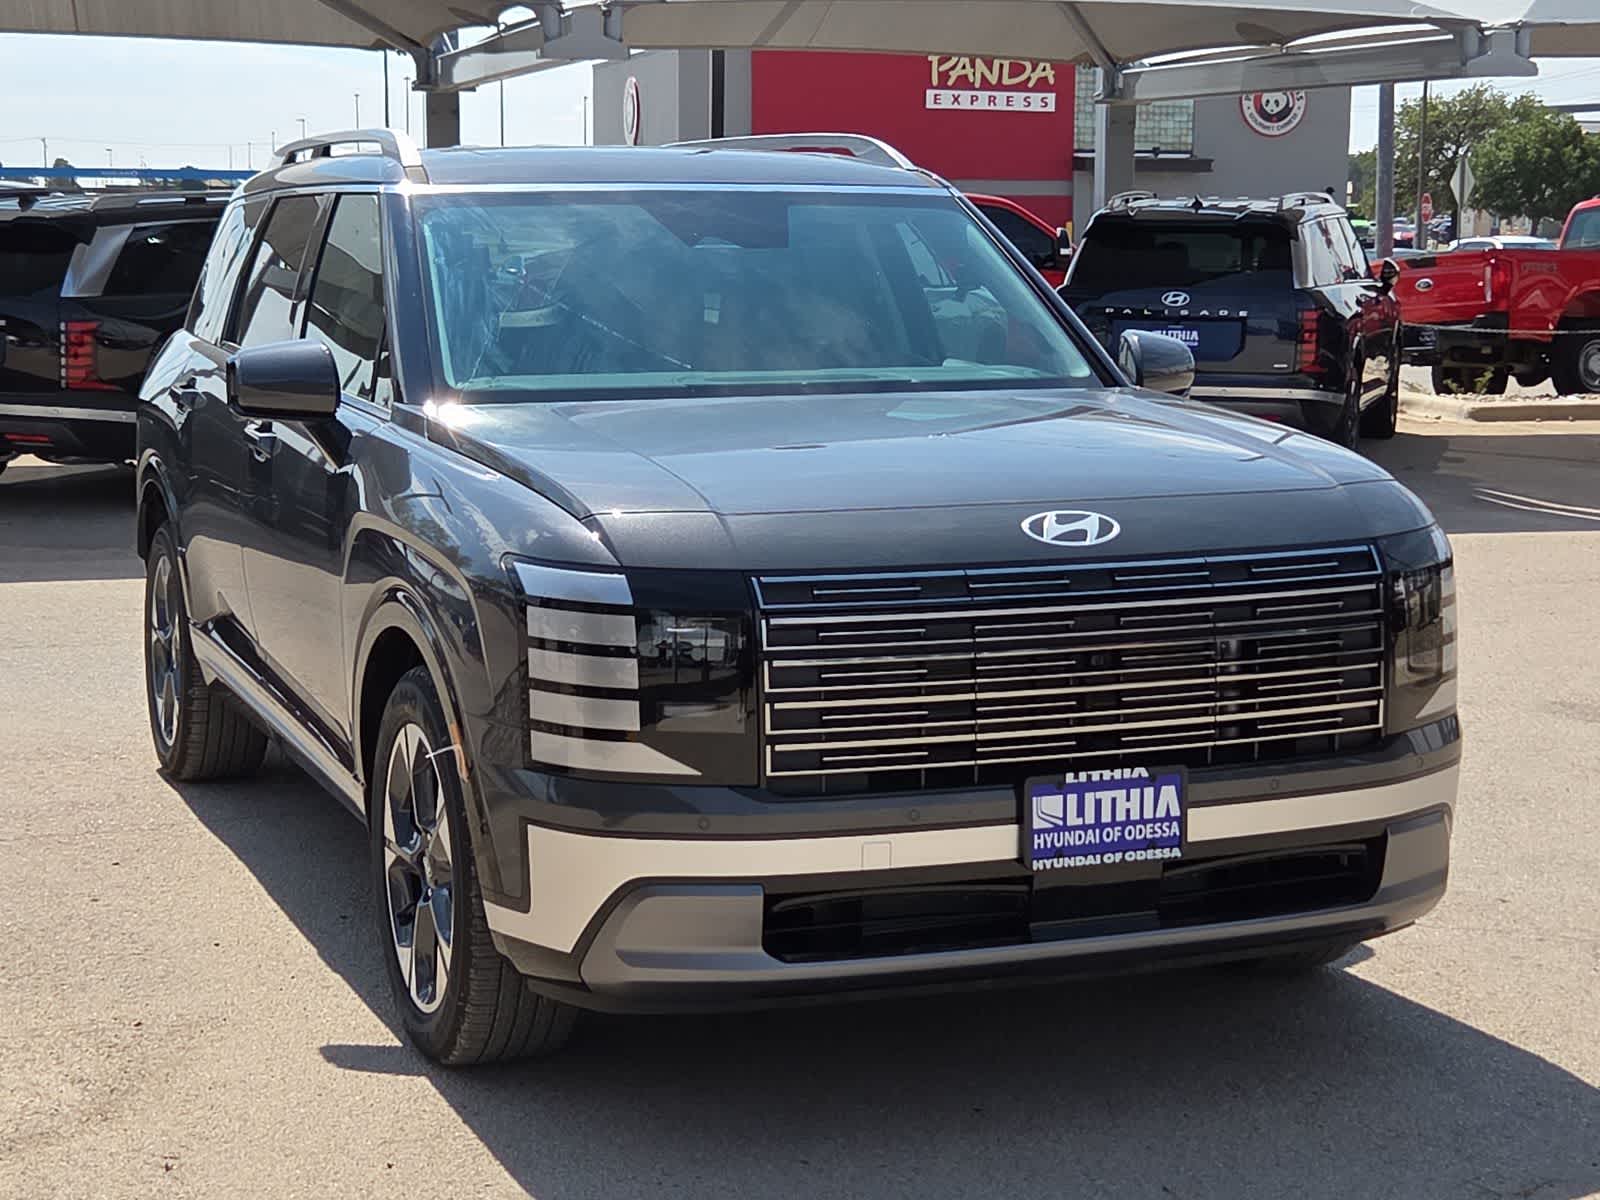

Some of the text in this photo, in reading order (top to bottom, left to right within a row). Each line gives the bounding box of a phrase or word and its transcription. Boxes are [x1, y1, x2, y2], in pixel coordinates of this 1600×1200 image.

[928, 55, 1055, 88] PANDA
[933, 93, 1049, 108] EXPRESS
[1105, 307, 1249, 317] PALISADE
[1066, 767, 1149, 784] LITHIA
[1066, 785, 1181, 826] LITHIA
[1033, 821, 1180, 849] HYUNDAI OF ODESSA
[1032, 847, 1181, 871] HYUNDAI OF ODESSA
